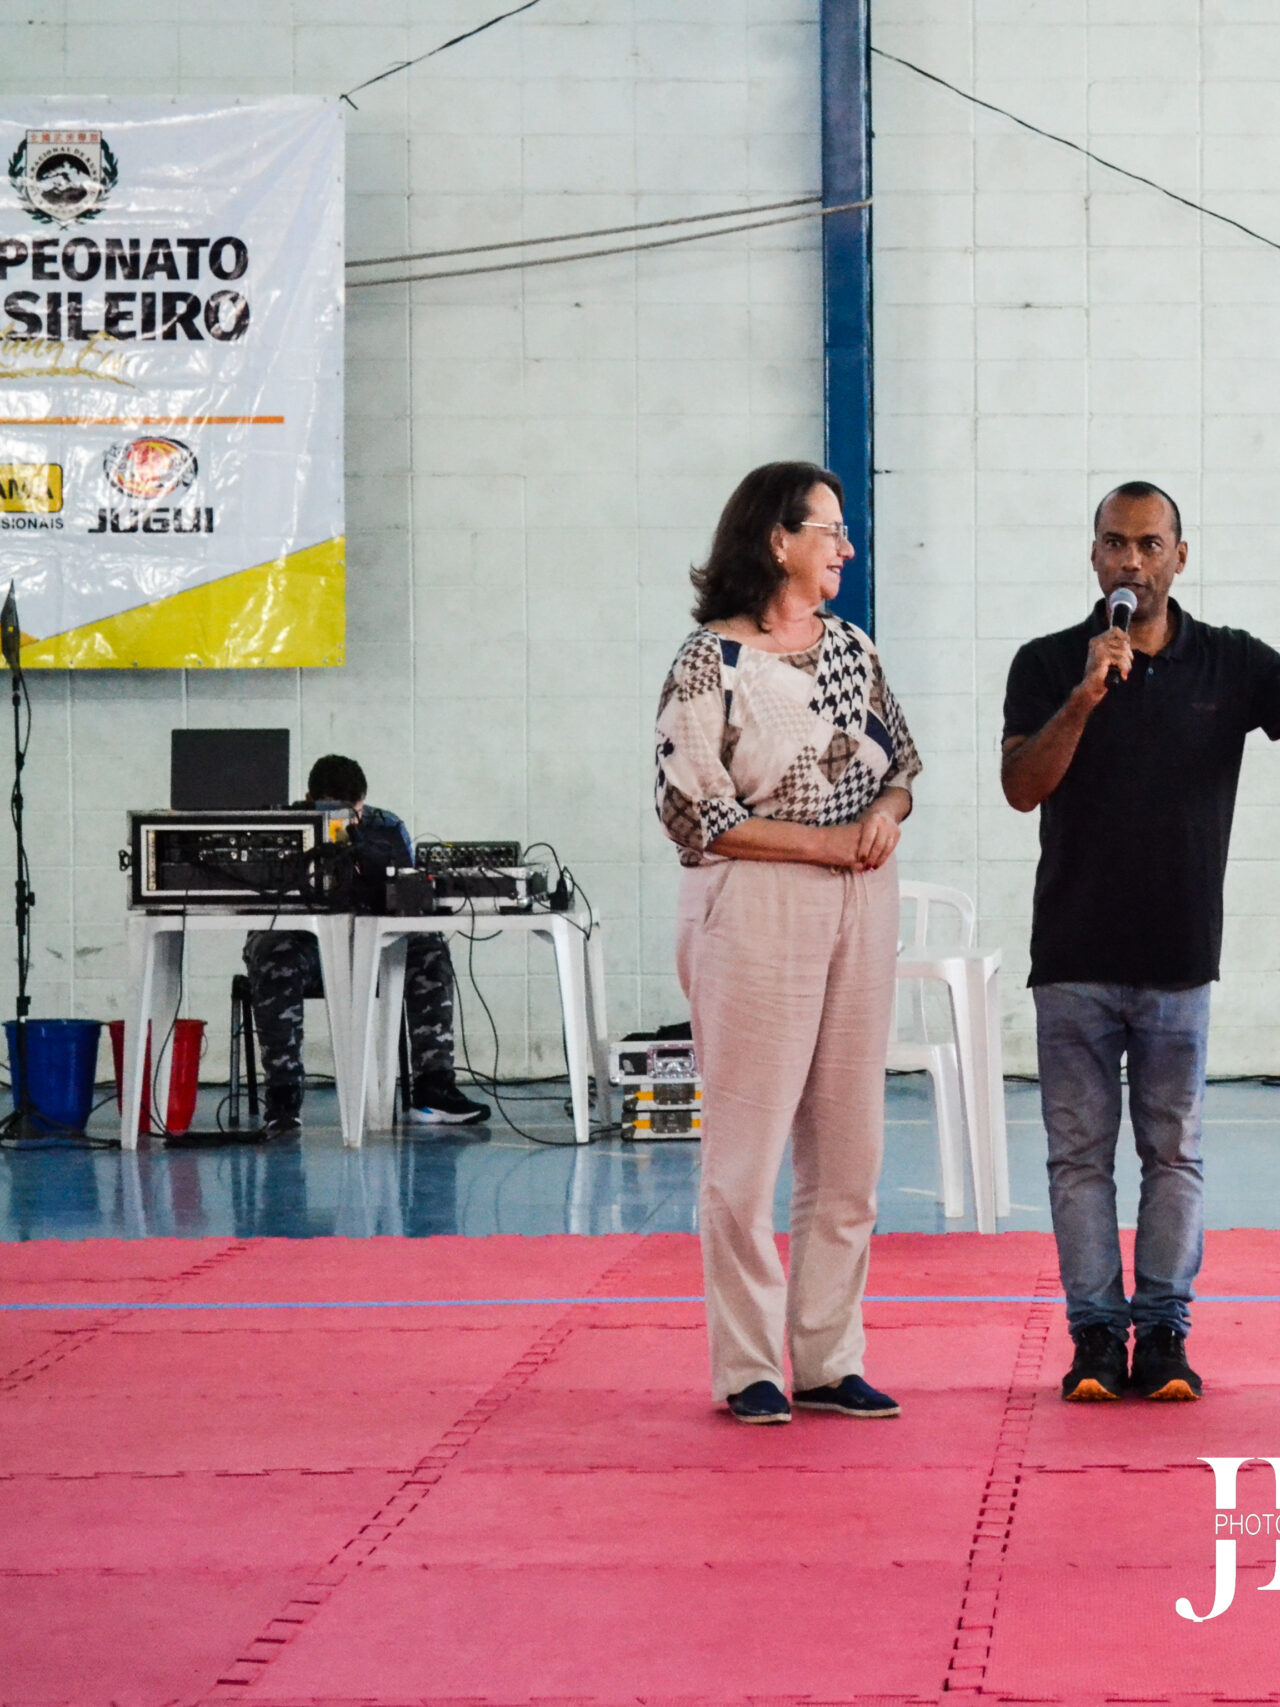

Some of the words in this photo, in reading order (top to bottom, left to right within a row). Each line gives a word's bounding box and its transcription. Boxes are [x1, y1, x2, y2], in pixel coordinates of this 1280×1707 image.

[0, 236, 249, 281] PEONATO
[3, 290, 250, 341] SILEIRO
[1, 517, 64, 530] SIONAIS
[88, 507, 214, 533] JUGUI
